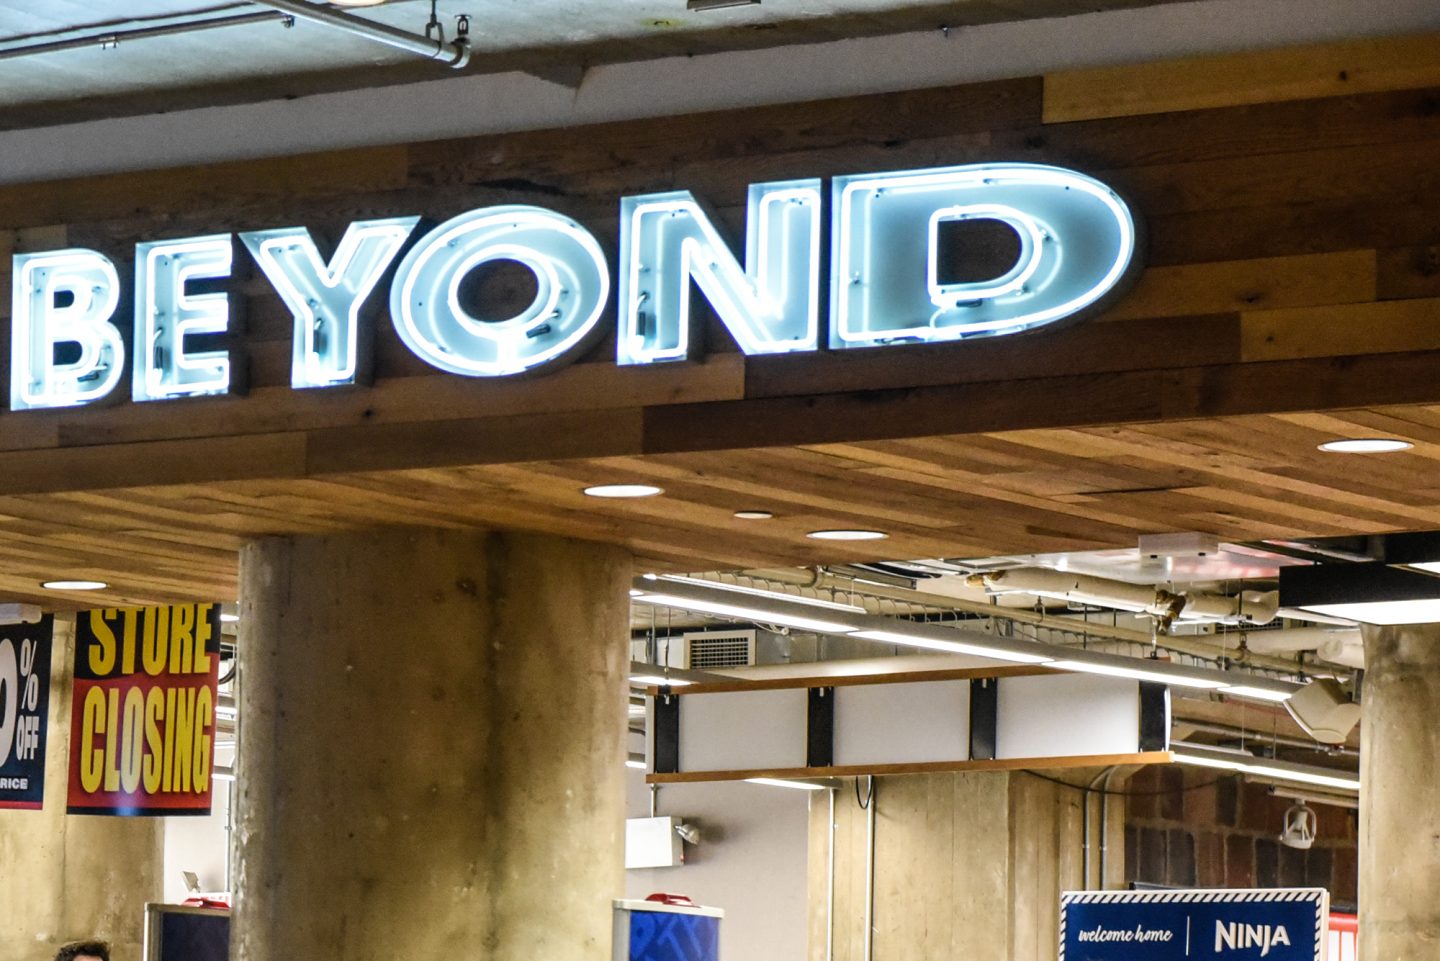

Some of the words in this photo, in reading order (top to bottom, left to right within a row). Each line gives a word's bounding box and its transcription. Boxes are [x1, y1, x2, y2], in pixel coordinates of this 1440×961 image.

[9, 163, 1137, 413] BEYOND
[88, 603, 214, 676] STORE
[15, 715, 40, 761] OFF
[80, 685, 213, 795] CLOSING
[1078, 924, 1134, 943] welcome
[1134, 924, 1173, 943] home
[1214, 919, 1292, 958] NINJA
